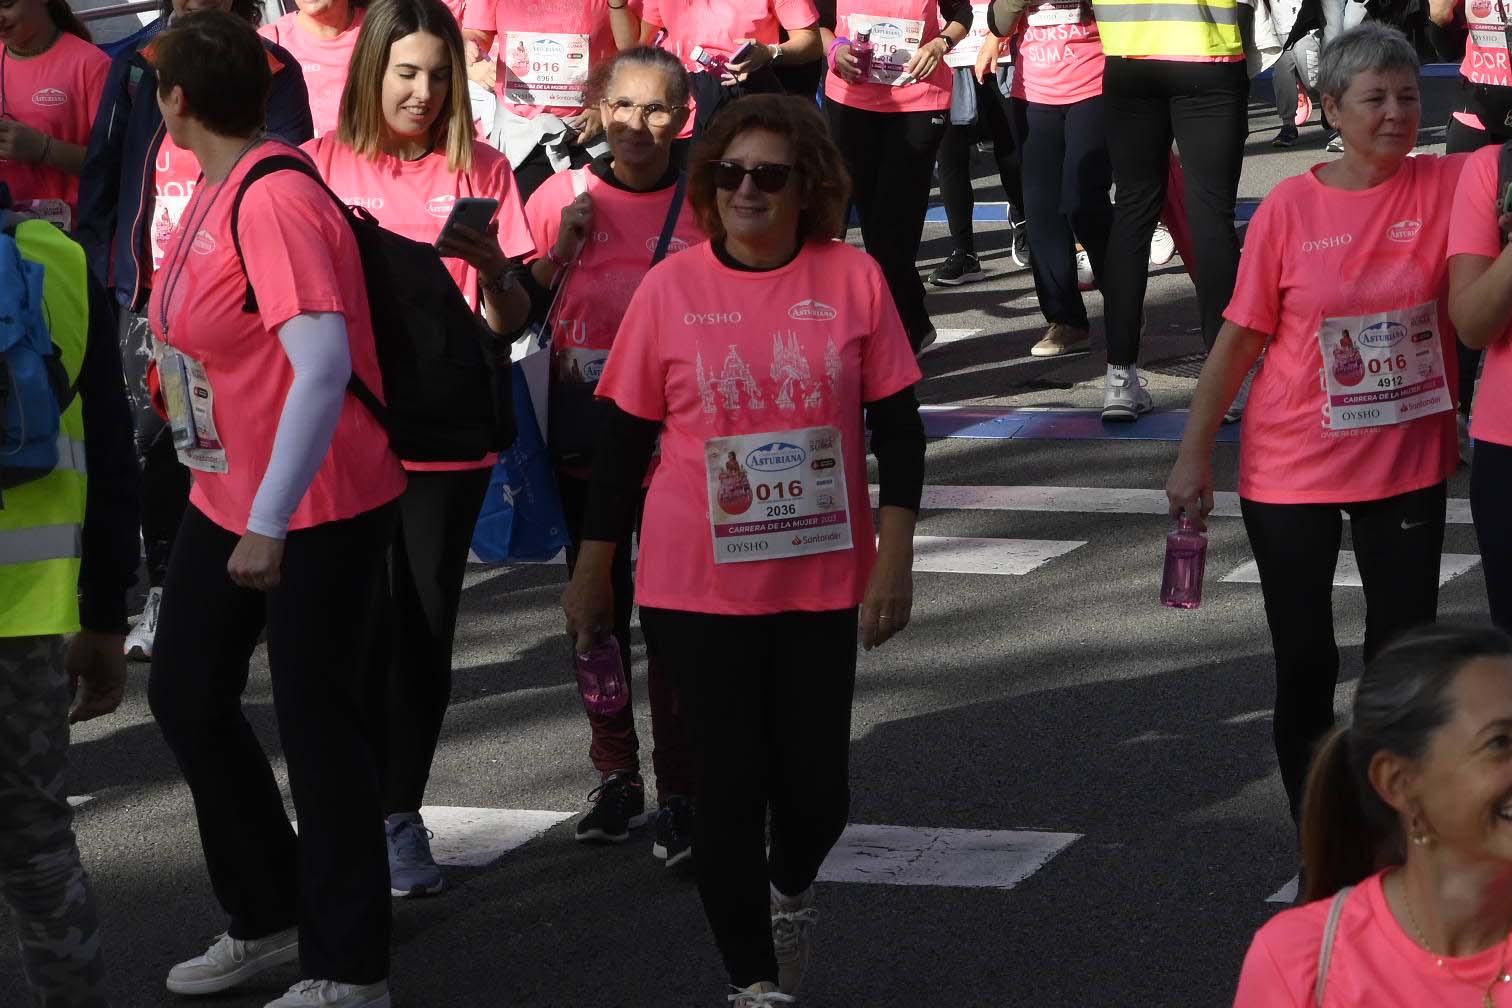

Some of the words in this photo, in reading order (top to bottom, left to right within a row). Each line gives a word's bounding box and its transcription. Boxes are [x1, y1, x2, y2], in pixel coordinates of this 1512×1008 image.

[1028, 47, 1076, 63] SUMA
[532, 62, 560, 72] 016
[1301, 233, 1352, 253] OYSHO
[684, 311, 742, 325] OYSHO
[1361, 330, 1405, 343] ASTURIANA
[1367, 354, 1407, 374] 016
[1377, 375, 1403, 388] 4912
[1343, 394, 1377, 404] CARRERA
[1390, 391, 1399, 399] LA
[1342, 408, 1380, 421] OYSHO
[749, 453, 803, 467] ASTURIANA
[756, 480, 803, 501] 016
[766, 503, 796, 517] 2036
[728, 523, 765, 534] CARRERA
[766, 522, 779, 531] DE
[780, 521, 791, 530] LA
[792, 517, 818, 528] MUJER
[727, 540, 768, 553] OYSHO
[802, 532, 841, 545] Santander
